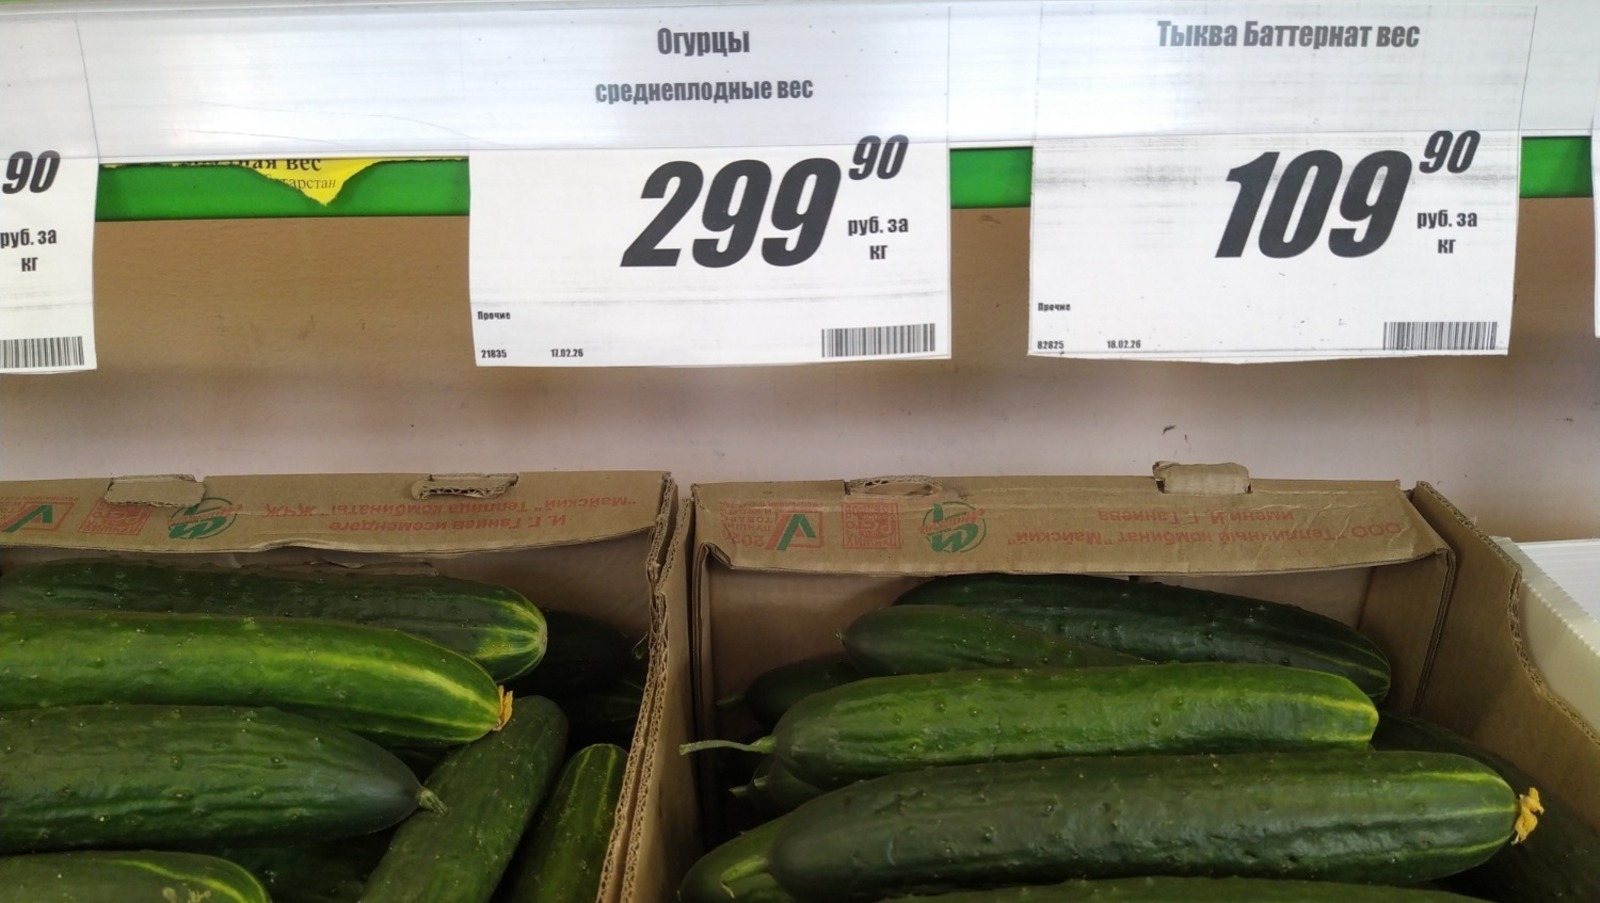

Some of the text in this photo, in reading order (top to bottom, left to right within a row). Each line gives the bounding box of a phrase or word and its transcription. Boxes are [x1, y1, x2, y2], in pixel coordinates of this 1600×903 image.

[657, 27, 750, 57] Огурцы
[1157, 20, 1420, 49] Тыква Баттернат вес
[595, 78, 814, 105] среднеплодные вес
[848, 134, 909, 181] 90
[1419, 129, 1481, 174] 90
[1, 149, 61, 195] 90
[1215, 149, 1413, 259] 109
[620, 157, 841, 269] 299
[1417, 210, 1478, 230] руб. за
[847, 216, 909, 236] руб. за
[0, 228, 57, 249] руб. за
[1437, 238, 1456, 254] кг
[869, 245, 888, 260] кг
[21, 257, 39, 272] кг
[1037, 302, 1071, 312] Прочие
[477, 310, 511, 321] Прочие
[1037, 340, 1065, 350] 82825
[1107, 340, 1141, 349] 18.02.26
[481, 349, 507, 359] 21835
[550, 348, 584, 358] 17.02.26
[448, 501, 528, 515] Теплица
[453, 517, 521, 531] Ганиев
[1098, 510, 1180, 525] Ганиева
[1229, 510, 1294, 524] имени
[1118, 530, 1212, 545] комбинат
[1351, 522, 1402, 538] ООО
[1007, 531, 1112, 546] "Майский"
